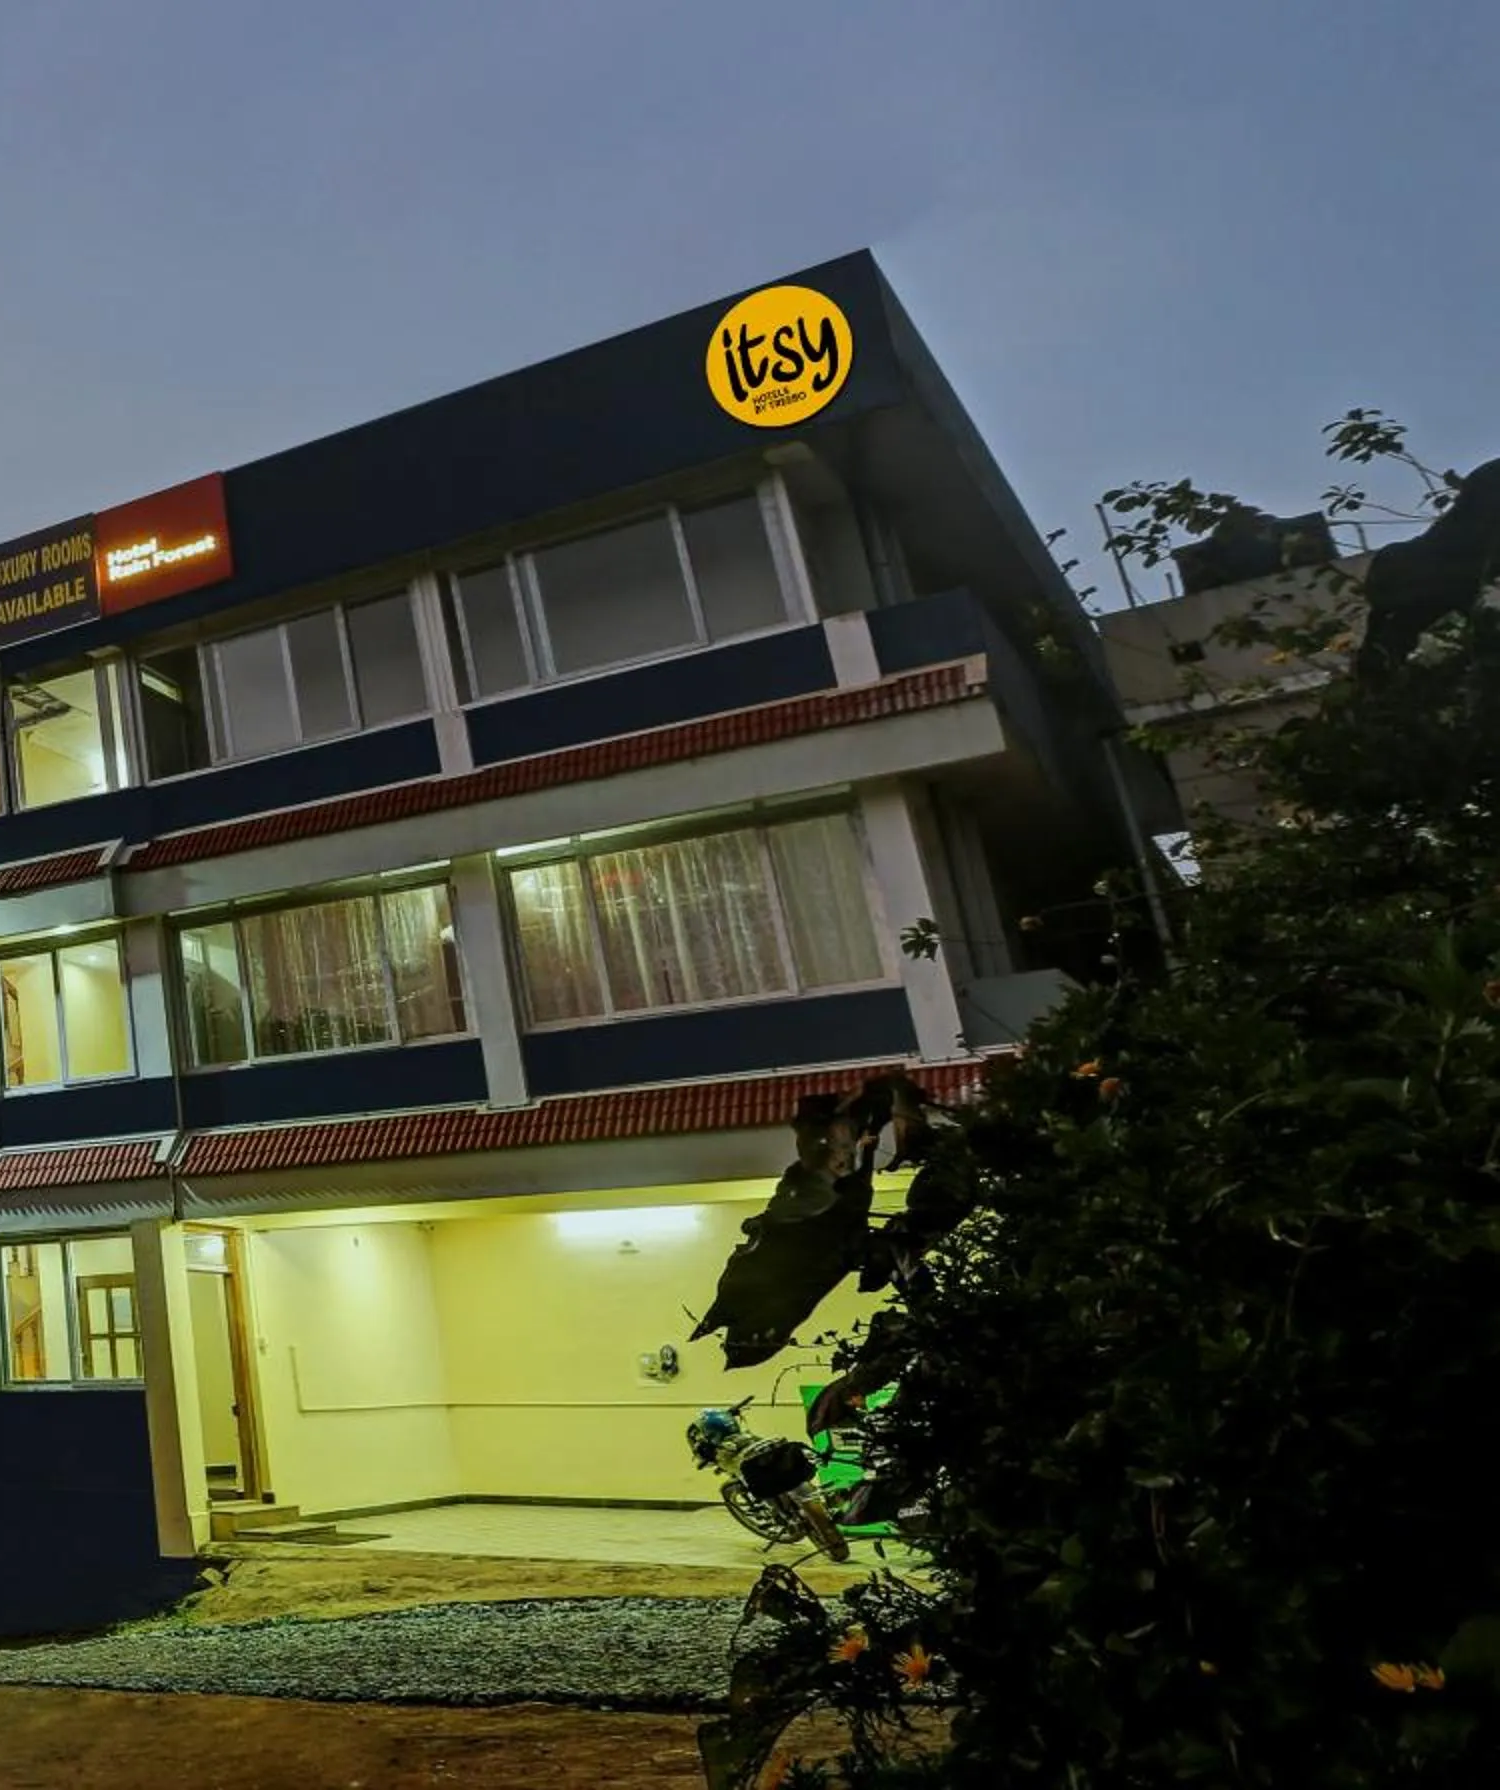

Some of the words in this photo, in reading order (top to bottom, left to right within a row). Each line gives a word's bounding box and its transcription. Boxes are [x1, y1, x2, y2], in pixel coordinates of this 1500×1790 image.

[722, 317, 839, 402] itsy
[41, 532, 92, 573] ROOMS
[106, 537, 157, 566] Hotel
[108, 558, 151, 582] Rain
[153, 534, 216, 568] Forest
